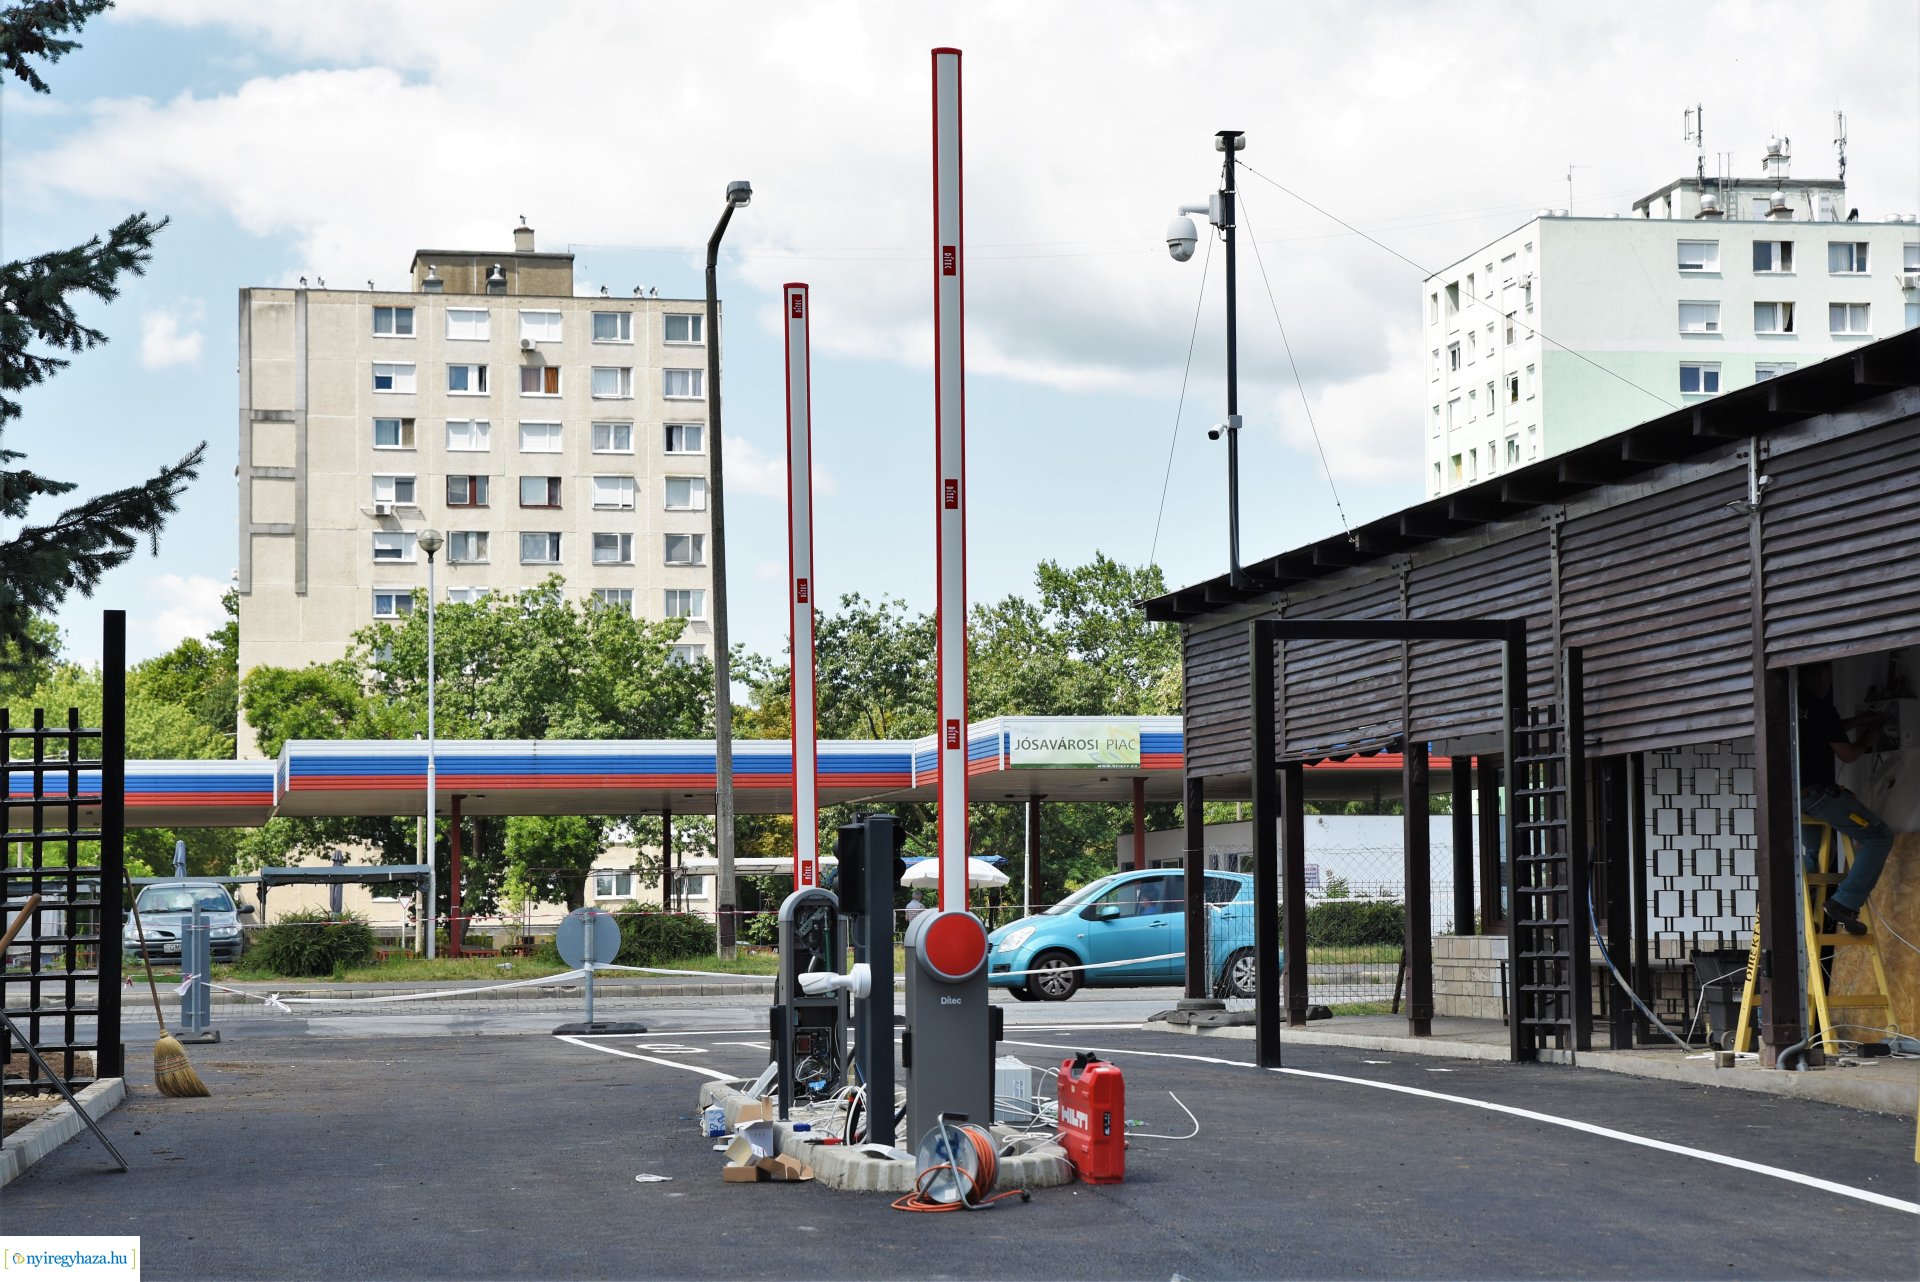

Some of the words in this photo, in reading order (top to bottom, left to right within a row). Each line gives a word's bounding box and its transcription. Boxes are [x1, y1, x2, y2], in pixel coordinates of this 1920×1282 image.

[1014, 736, 1099, 751] JÓSAVÁROSI
[1106, 738, 1136, 751] PIAC
[1061, 1106, 1088, 1131] HILTI
